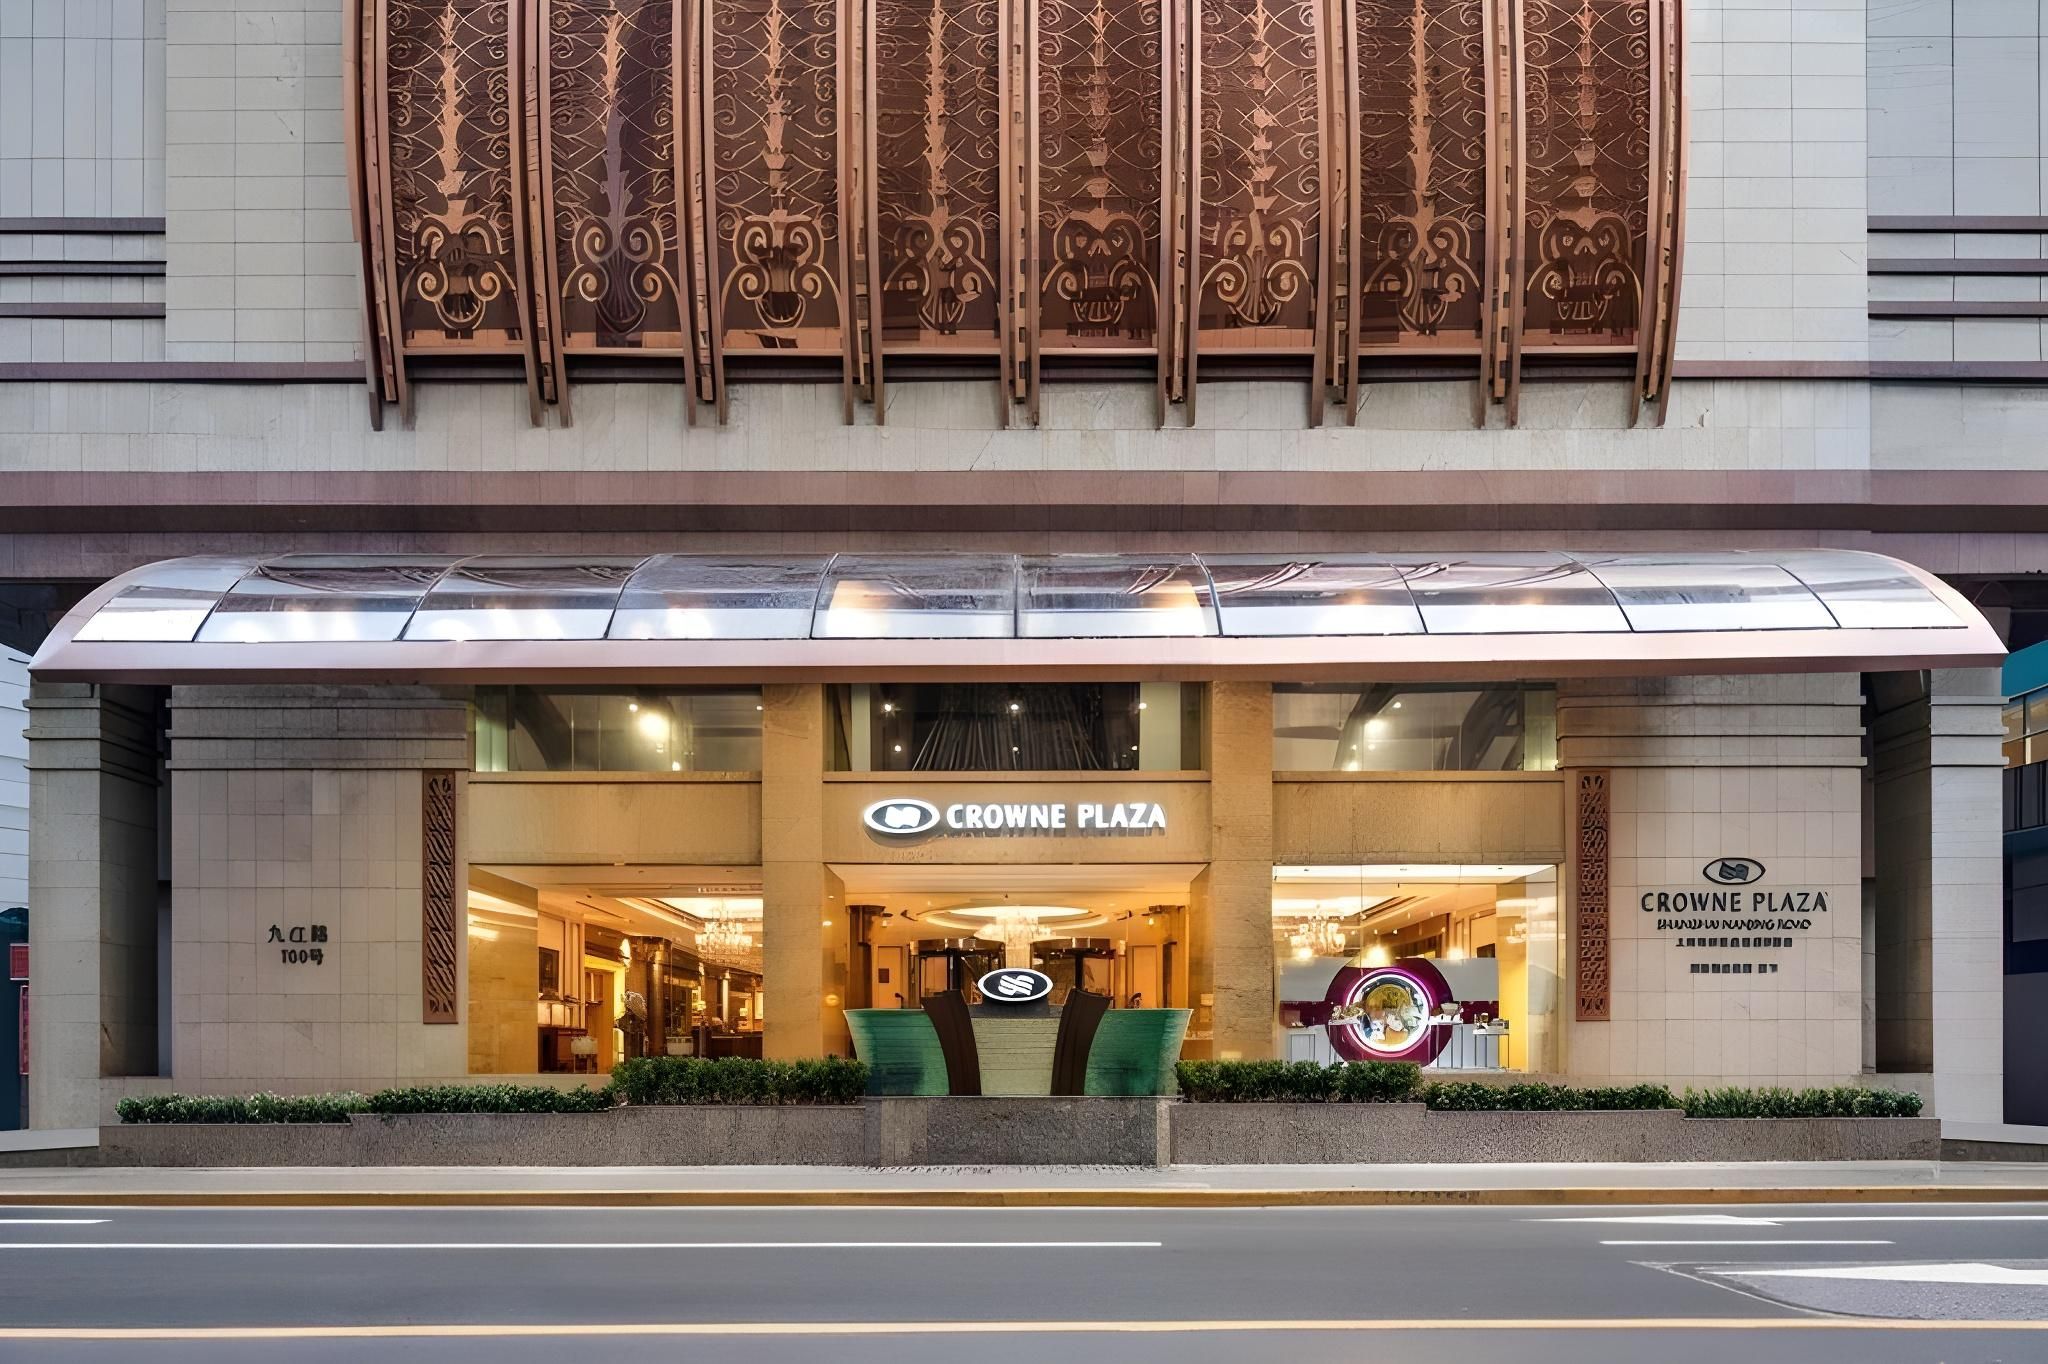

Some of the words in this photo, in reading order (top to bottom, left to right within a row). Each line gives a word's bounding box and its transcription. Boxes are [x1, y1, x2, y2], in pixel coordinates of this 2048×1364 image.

[946, 803, 1066, 829] CROWNE
[1077, 803, 1166, 828] PLAZA
[1641, 892, 1742, 913] CROWNE
[1752, 892, 1827, 913] PLAZA
